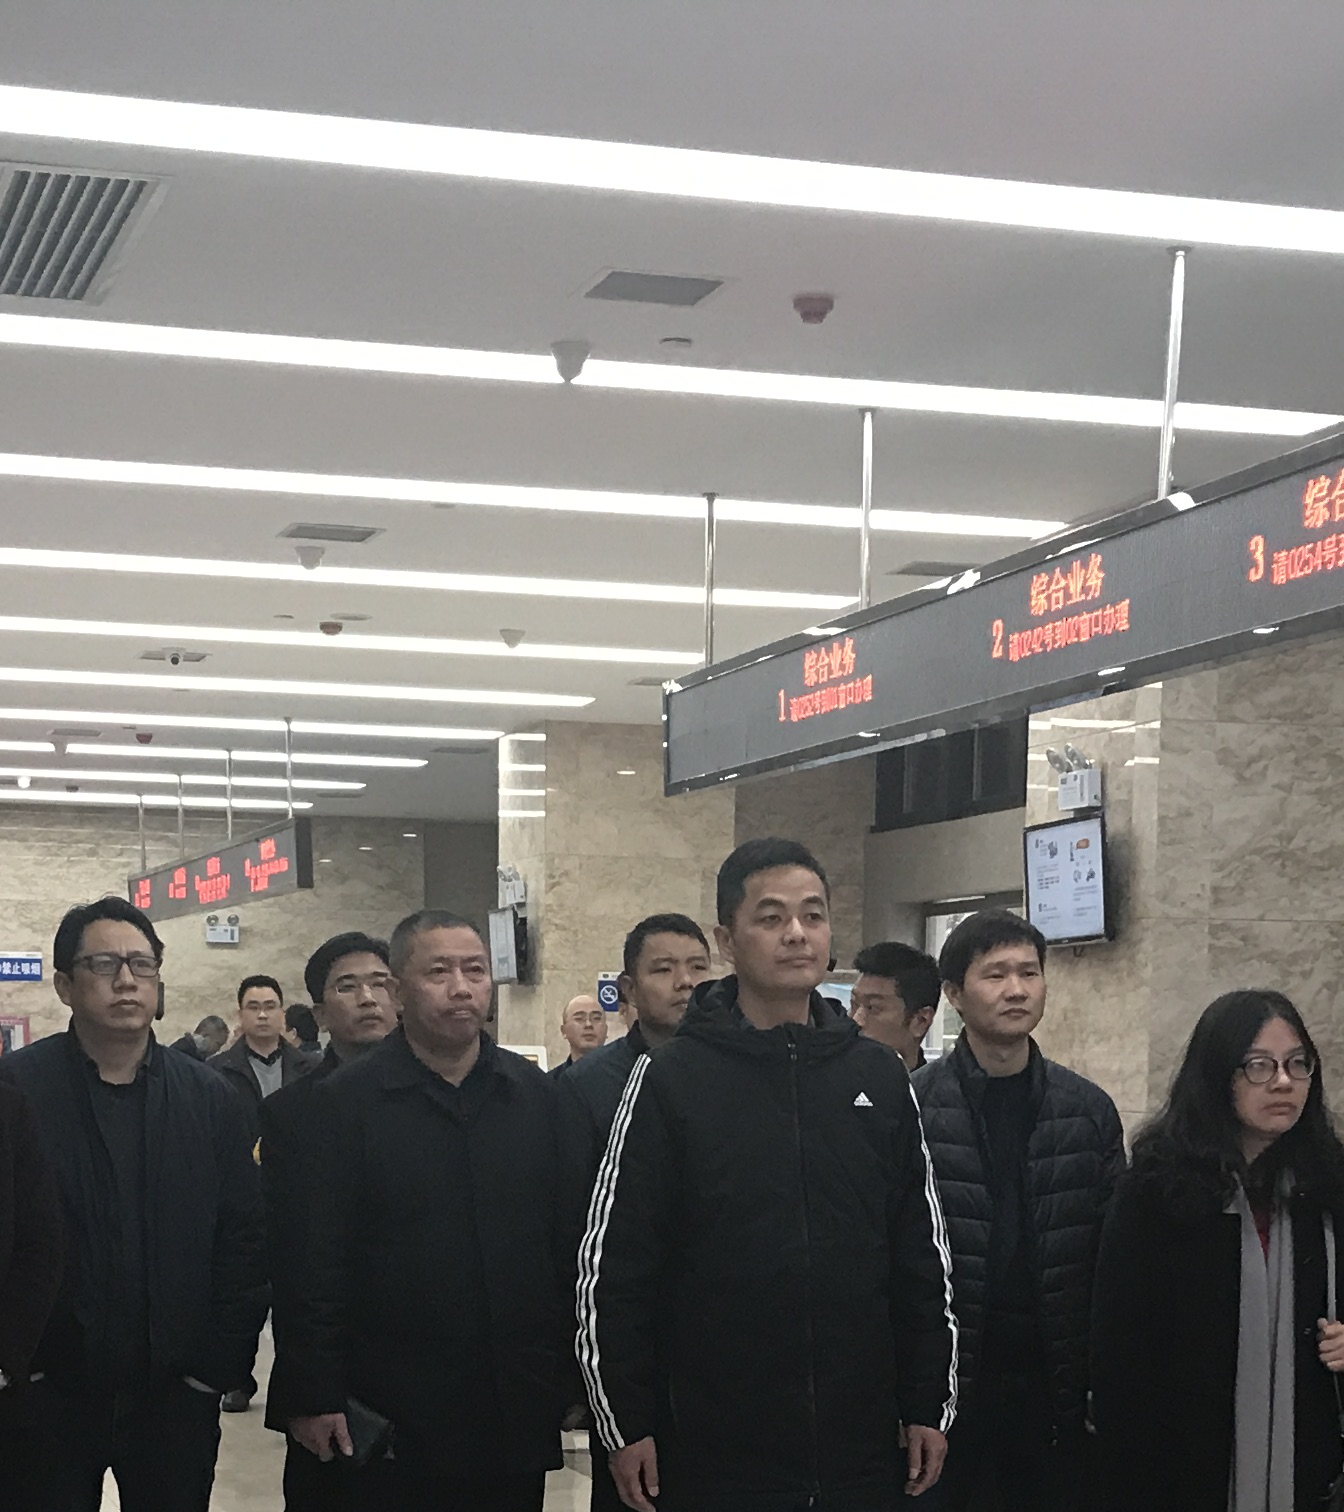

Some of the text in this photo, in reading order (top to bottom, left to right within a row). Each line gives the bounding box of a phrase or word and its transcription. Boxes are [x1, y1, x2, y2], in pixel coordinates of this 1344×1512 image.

[1247, 535, 1265, 582] 3
[1030, 553, 1105, 616] 综合业务
[991, 619, 1004, 659] 2
[804, 640, 856, 687] 综合业务
[778, 689, 786, 722] 1
